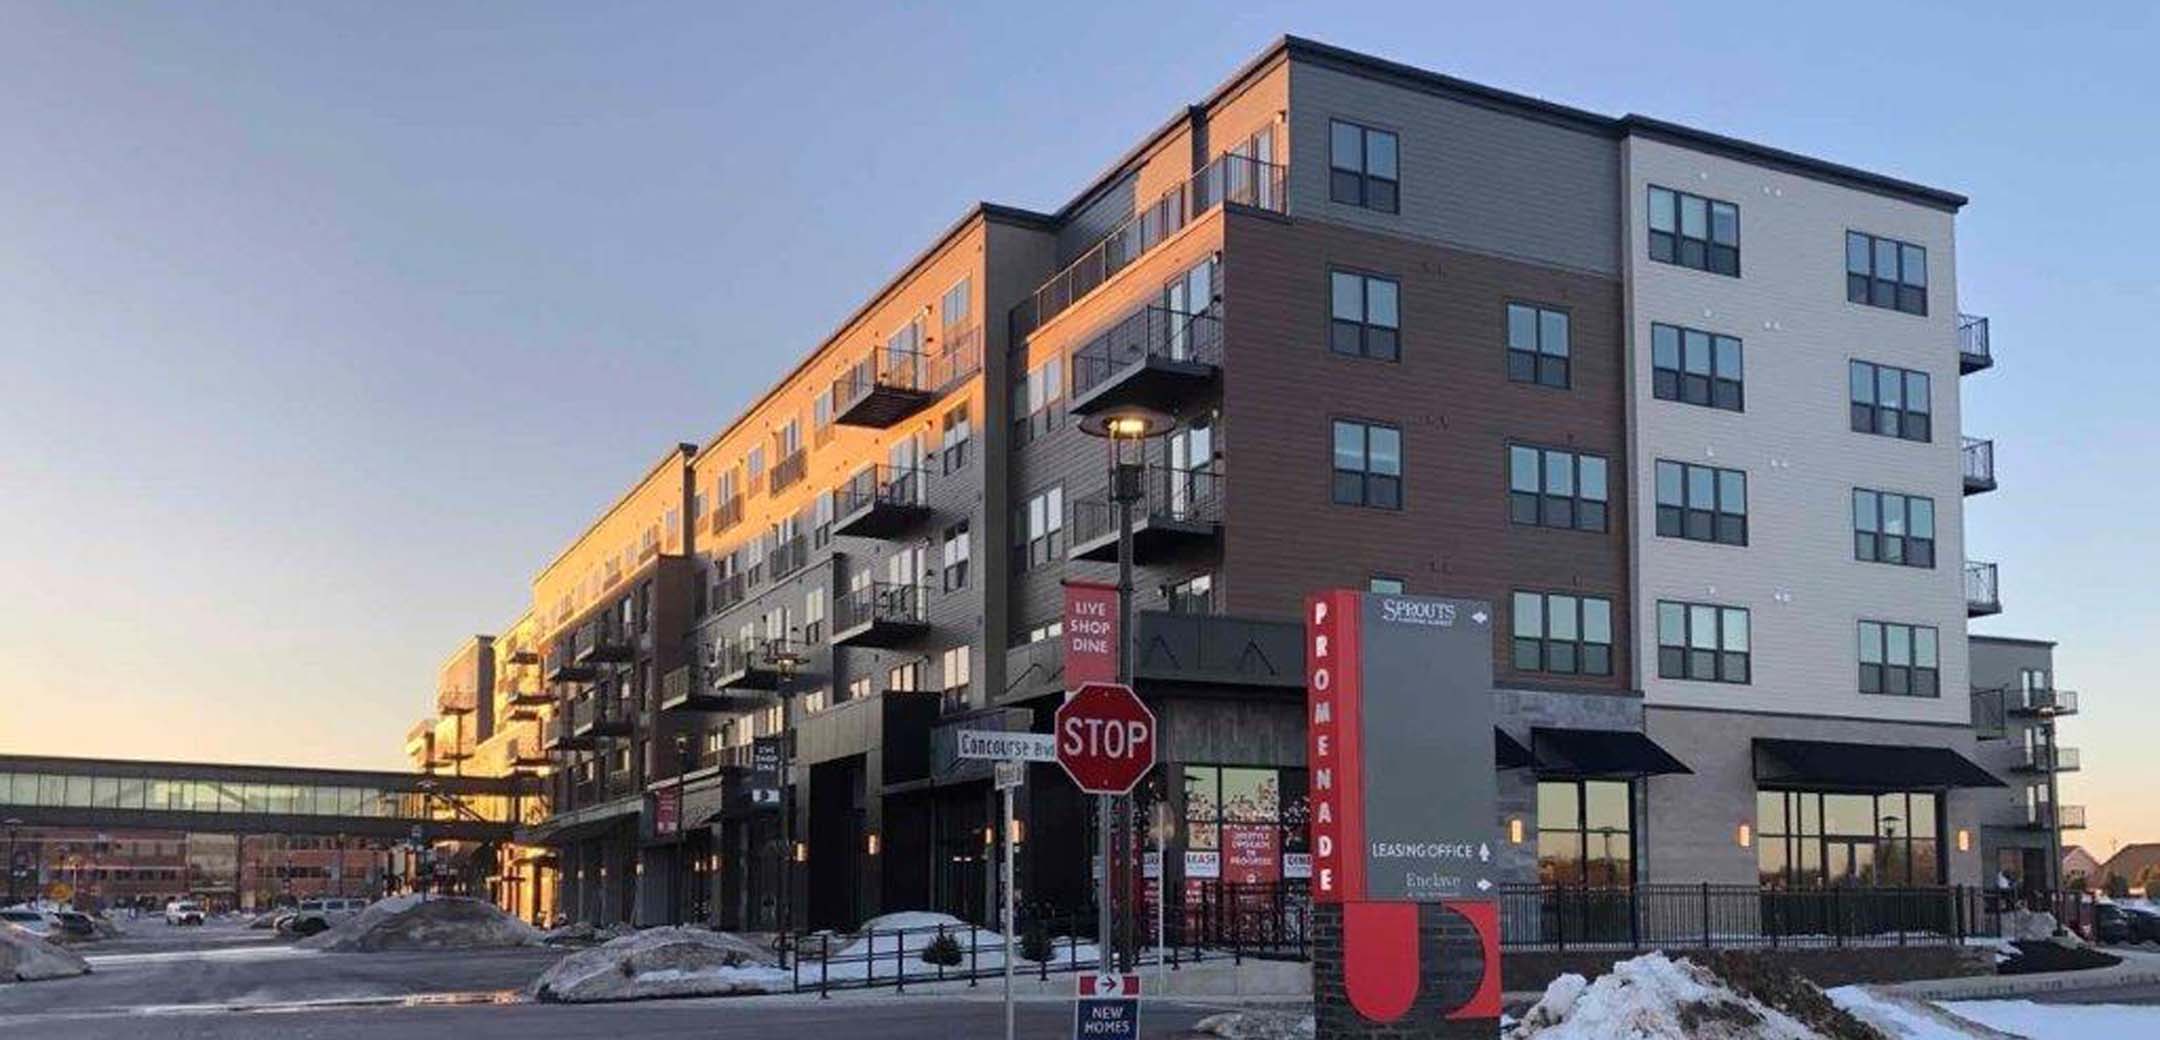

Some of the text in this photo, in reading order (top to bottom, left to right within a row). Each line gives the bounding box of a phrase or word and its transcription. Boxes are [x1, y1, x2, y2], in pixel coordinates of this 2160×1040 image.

[1075, 602, 1106, 616] LIVE
[1382, 598, 1456, 621] SPROUTS
[1070, 620, 1110, 634] SHOP
[1072, 638, 1108, 653] DINE
[961, 733, 1029, 756] Concourse
[1063, 716, 1148, 758] STOP
[1314, 602, 1333, 890] PROMENADE
[1372, 842, 1473, 858] LEASING OFFICE
[1092, 1007, 1123, 1020] NEW
[1084, 1020, 1130, 1034] HOMES
